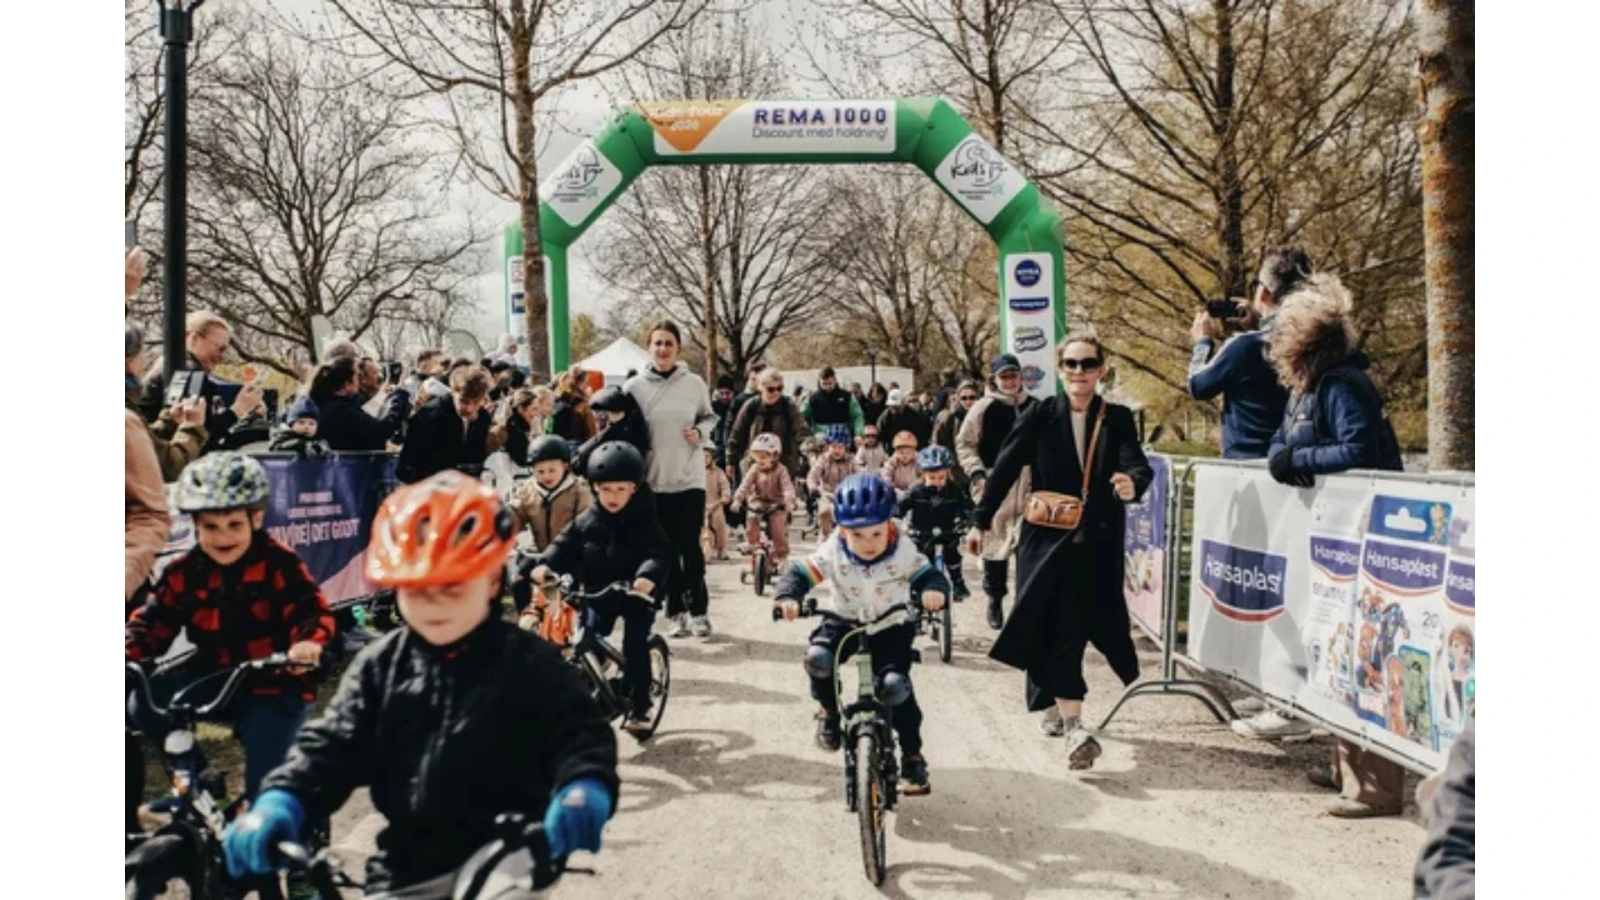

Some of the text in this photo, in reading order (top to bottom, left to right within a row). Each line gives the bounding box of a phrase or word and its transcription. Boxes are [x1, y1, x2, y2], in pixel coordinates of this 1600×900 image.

[754, 107, 887, 125] REMA 1000
[752, 127, 888, 142] Discount med holdning!
[311, 521, 330, 543] DET
[1366, 550, 1438, 580] Hansaplast
[1422, 610, 1439, 628] 20
